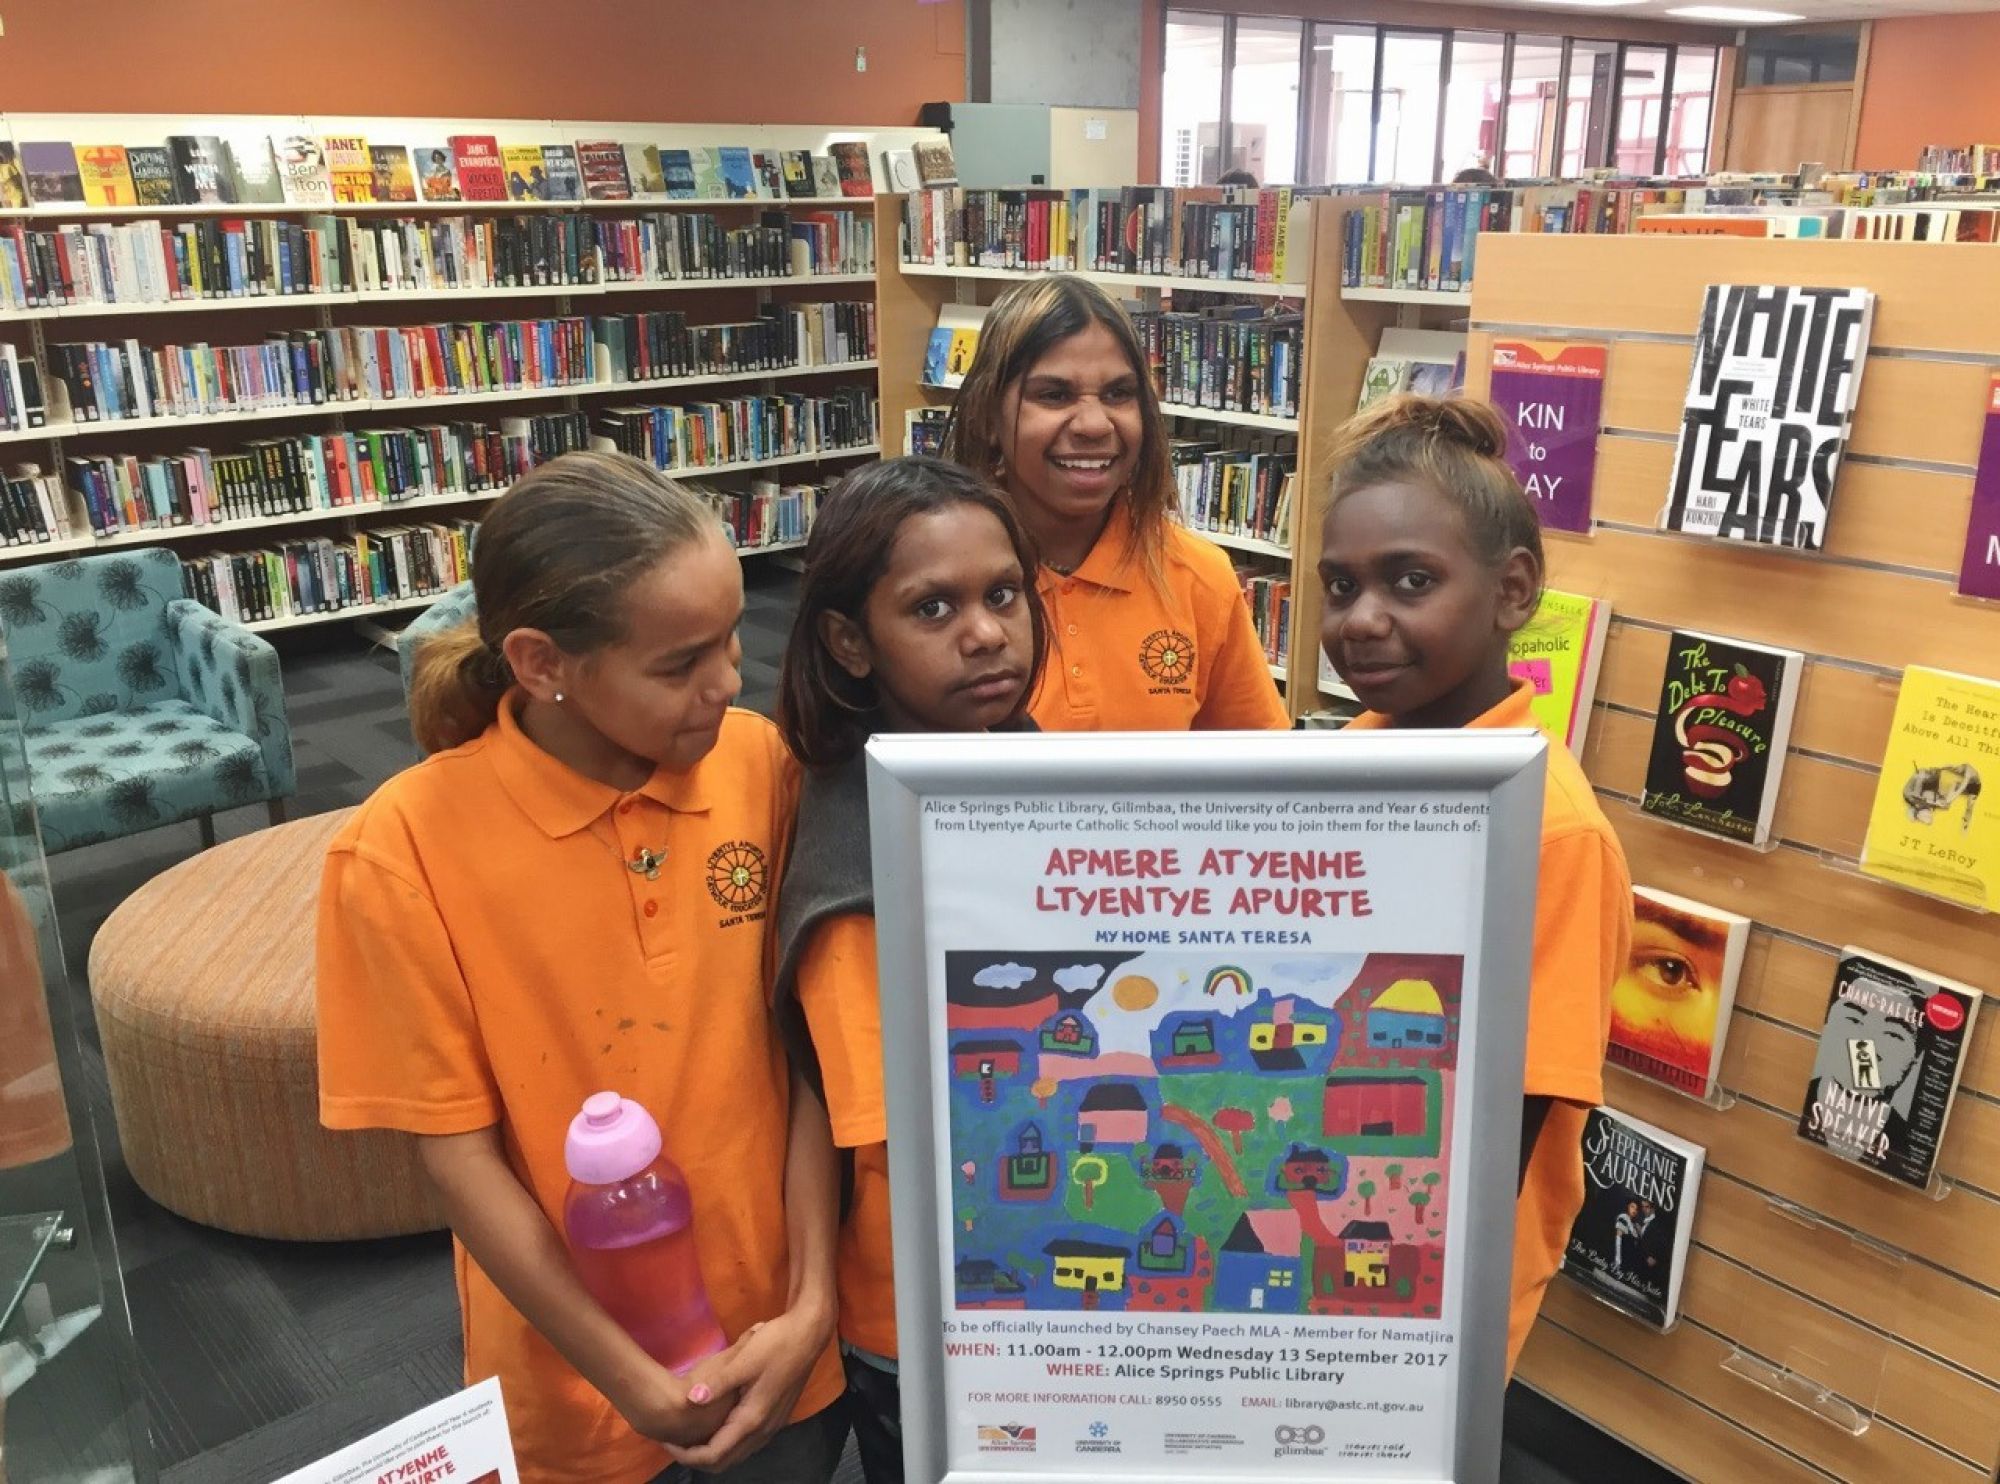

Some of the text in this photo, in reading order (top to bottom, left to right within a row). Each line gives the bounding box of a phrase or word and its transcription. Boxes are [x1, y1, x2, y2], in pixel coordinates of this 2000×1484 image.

[325, 138, 364, 151] JANET
[287, 163, 317, 176] Ben
[1276, 224, 1287, 257] JAMES
[1518, 401, 1565, 431] KIN
[1741, 397, 1771, 413] WHITE
[1739, 413, 1768, 430] TEARS
[1529, 442, 1546, 461] to
[1695, 493, 1717, 509] HARI
[1511, 636, 1571, 657] opaholic
[1679, 642, 1711, 671] The
[1667, 672, 1708, 716] Debt
[1707, 668, 1729, 694] To
[1921, 709, 1936, 723] Is
[1935, 696, 2000, 722] The Hear
[1693, 707, 1768, 755] Pleasure
[1901, 721, 2000, 757] Above All Thi
[924, 802, 1491, 816] Alice Springs Public Library, Gilimbaa, the University of Canberra and Year 6 students
[935, 819, 1481, 834] from Ltyentye Apurte Catholic School would like you to join them for the launch of:
[1899, 834, 1979, 871] JT LeRoy
[1045, 847, 1367, 884] APMERE ATYENHE
[1035, 884, 1374, 918] LTYENTYE APURTE
[719, 916, 744, 929] SANTA
[1095, 930, 1312, 944] MY HOME SANTA TERESA
[1825, 1081, 1891, 1130] NATIVE
[1807, 1101, 1891, 1161] SPEAKER
[1586, 1116, 1680, 1185] STEPHANIE
[1584, 1152, 1677, 1213] LAURENS
[943, 1322, 957, 1334] To
[961, 1322, 979, 1334] be
[982, 1321, 1043, 1335] officially
[1047, 1322, 1113, 1335] launched
[1116, 1323, 1134, 1337] by
[1137, 1323, 1199, 1338] Chansey
[1202, 1324, 1245, 1337] Paech
[1250, 1325, 1281, 1338] MLA
[1293, 1326, 1353, 1339] Member
[1357, 1327, 1378, 1339] for
[1381, 1328, 1454, 1344] Namatjira
[945, 1343, 1001, 1357] WHEN:
[1007, 1344, 1081, 1357] 11.00am
[1097, 1345, 1172, 1360] 12.00pm
[1176, 1346, 1274, 1363] Wednesday
[1279, 1349, 1300, 1362] 13
[1304, 1349, 1399, 1365] September
[1403, 1352, 1449, 1367] 2017
[1046, 1363, 1345, 1385] WHERE: Alice Springs Public Library
[967, 1392, 992, 1403] FOR
[994, 1392, 1029, 1404] MORE
[1032, 1393, 1116, 1404] INFORMATION
[1119, 1394, 1152, 1404] CALL:
[1155, 1395, 1187, 1406] 8950
[1189, 1396, 1223, 1407] 0555
[1241, 1397, 1282, 1408] EMAIL:
[1075, 1446, 1122, 1454] CANBERRA
[1274, 1446, 1324, 1458] gilimbaa
[377, 1445, 450, 1484] ATYENHE
